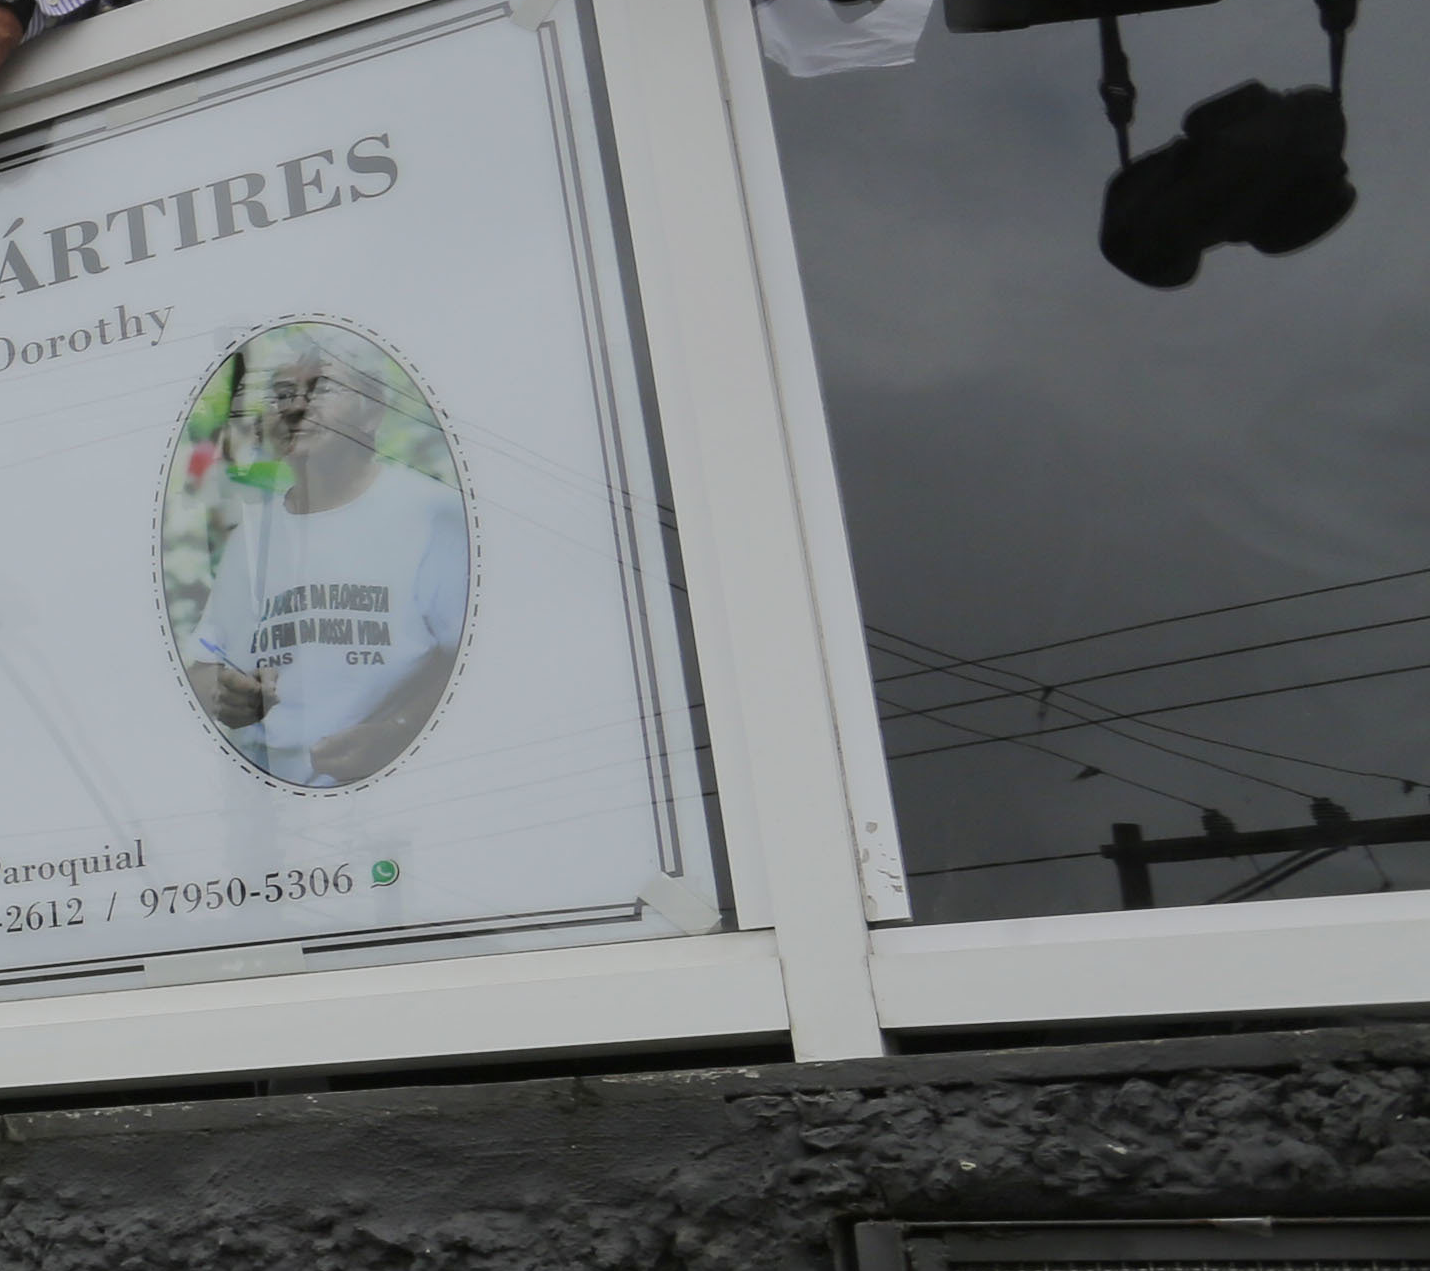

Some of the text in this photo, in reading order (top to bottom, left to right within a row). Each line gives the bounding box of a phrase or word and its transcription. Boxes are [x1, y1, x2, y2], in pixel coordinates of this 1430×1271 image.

[328, 583, 390, 613] FLORESTA
[357, 619, 391, 647] VIDA
[256, 652, 294, 669] CNS
[345, 650, 386, 666] GTA
[140, 863, 353, 918] 97950-5306
